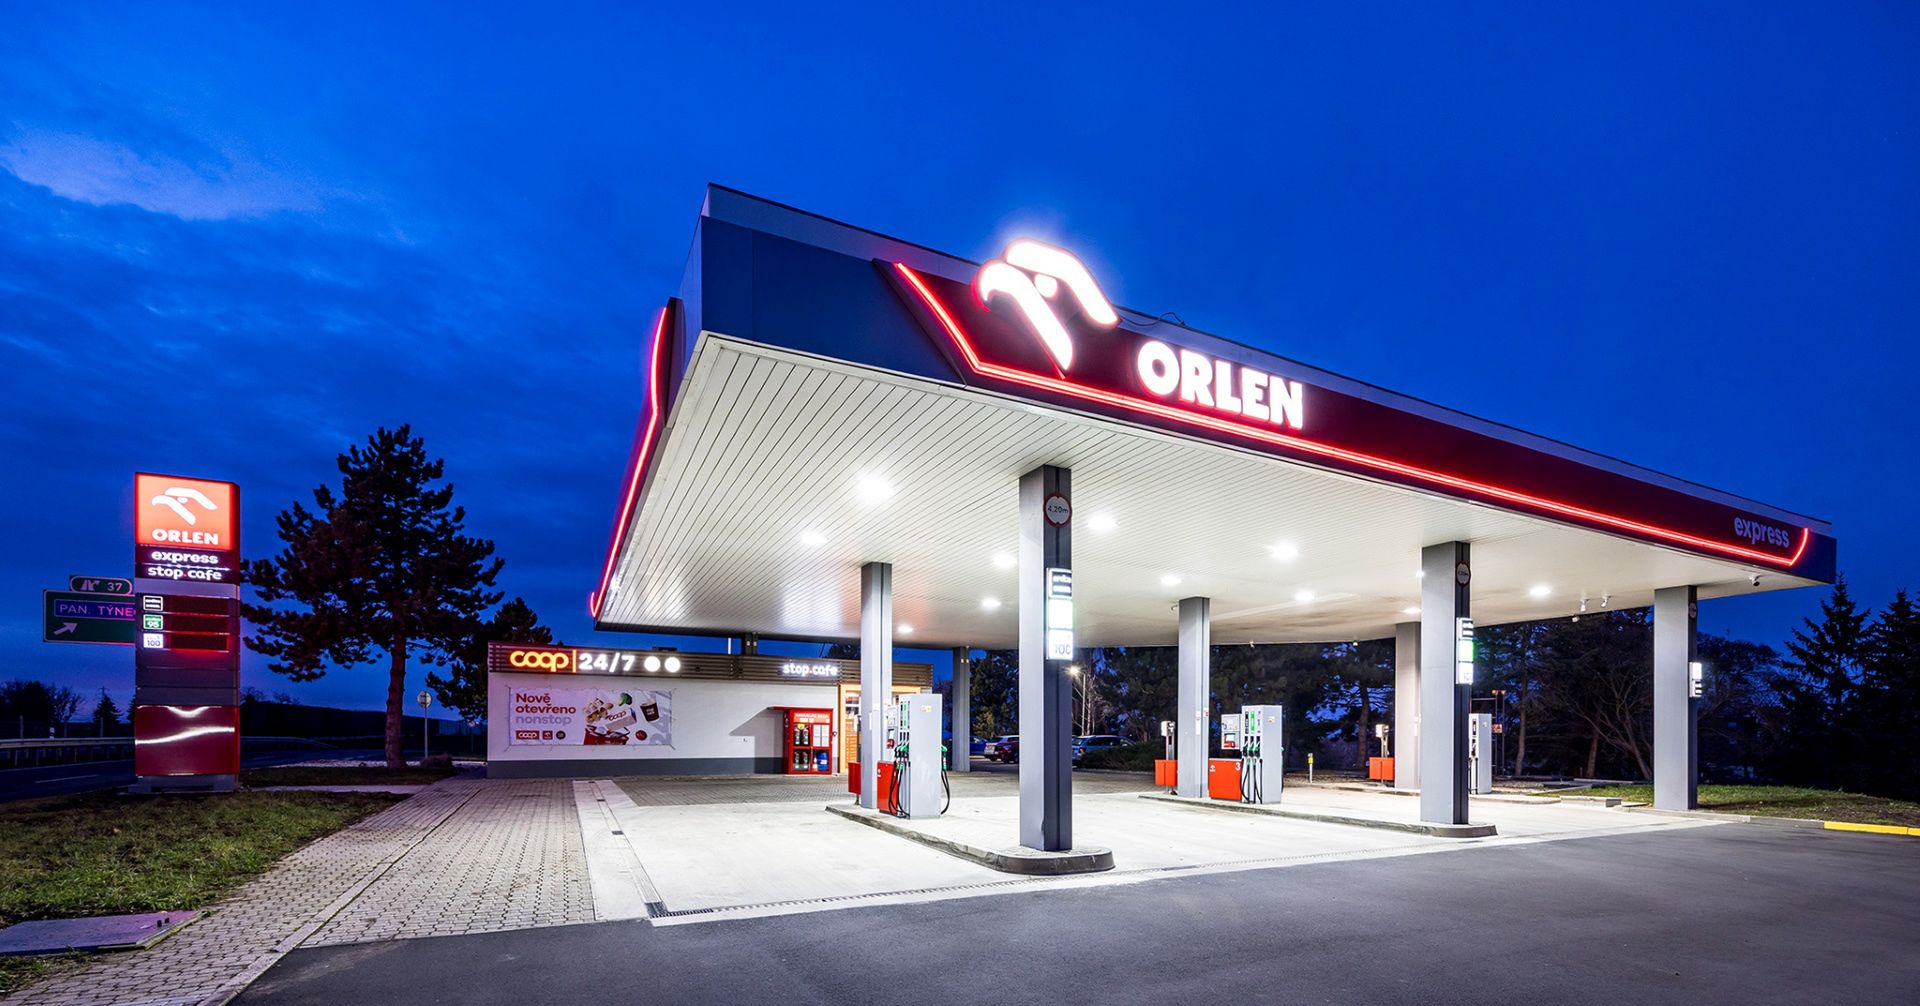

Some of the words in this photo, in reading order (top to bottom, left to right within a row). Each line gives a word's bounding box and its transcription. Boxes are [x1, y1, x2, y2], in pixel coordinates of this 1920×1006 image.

[1137, 340, 1304, 430] ORLEN
[151, 528, 219, 545] ORLEN
[1734, 516, 1790, 548] express
[151, 551, 219, 564] express
[107, 582, 123, 591] 37
[59, 604, 91, 614] PAN.
[97, 604, 136, 617] TÝNE
[1054, 643, 1072, 655] 100
[510, 650, 569, 672] coop
[578, 652, 635, 673] 24/7
[516, 692, 551, 704] Nově
[515, 703, 577, 714] otevřeno
[515, 715, 572, 726] nonstop
[609, 710, 626, 721] coop
[1235, 762, 1241, 771] 3
